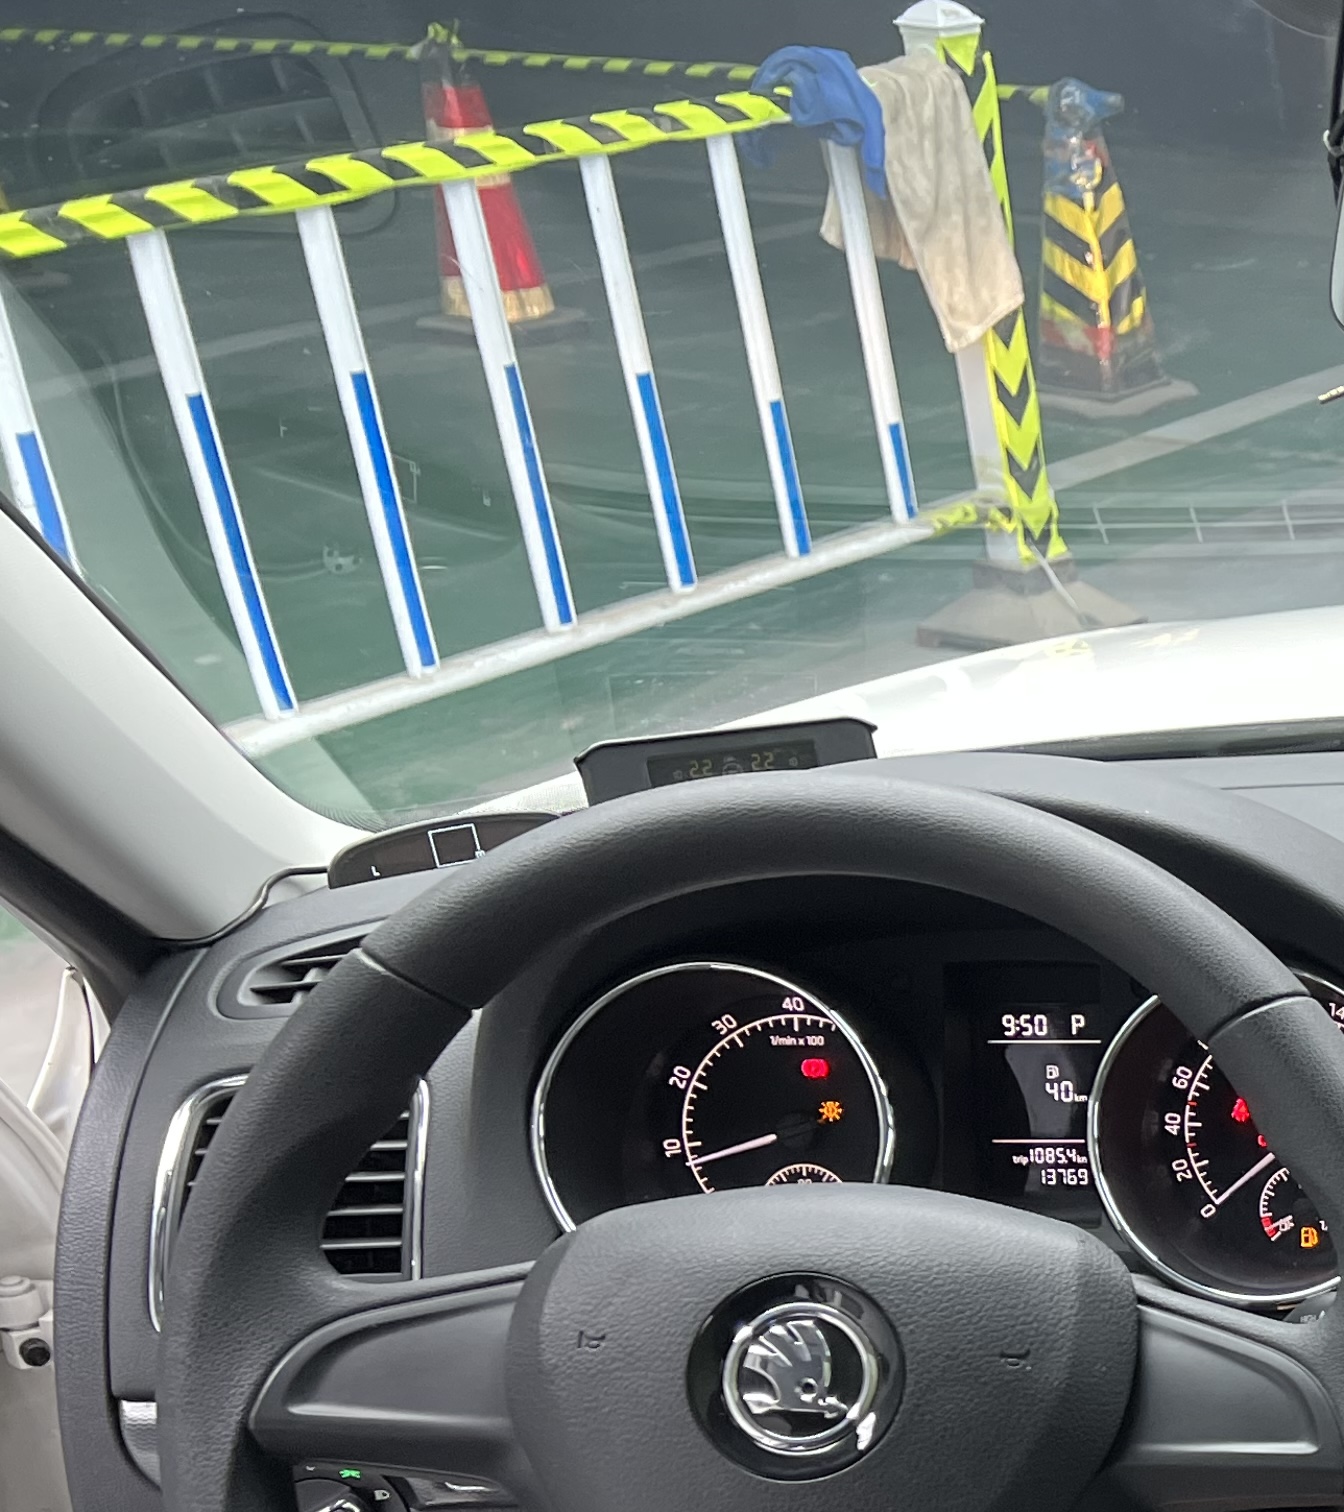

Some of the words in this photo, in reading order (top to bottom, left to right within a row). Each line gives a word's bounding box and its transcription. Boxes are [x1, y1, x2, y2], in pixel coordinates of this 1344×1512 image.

[782, 997, 805, 1012] 40
[711, 1014, 737, 1035] 30
[1002, 1014, 1048, 1037] 9:50
[1071, 1014, 1085, 1035] P
[669, 1065, 691, 1089] 20
[1172, 1066, 1193, 1090] 60
[1164, 1112, 1181, 1136] 40
[662, 1138, 682, 1158] 10
[1040, 1168, 1088, 1185] 13769
[1172, 1158, 1193, 1182] 20
[1200, 1203, 1217, 1218] 0
